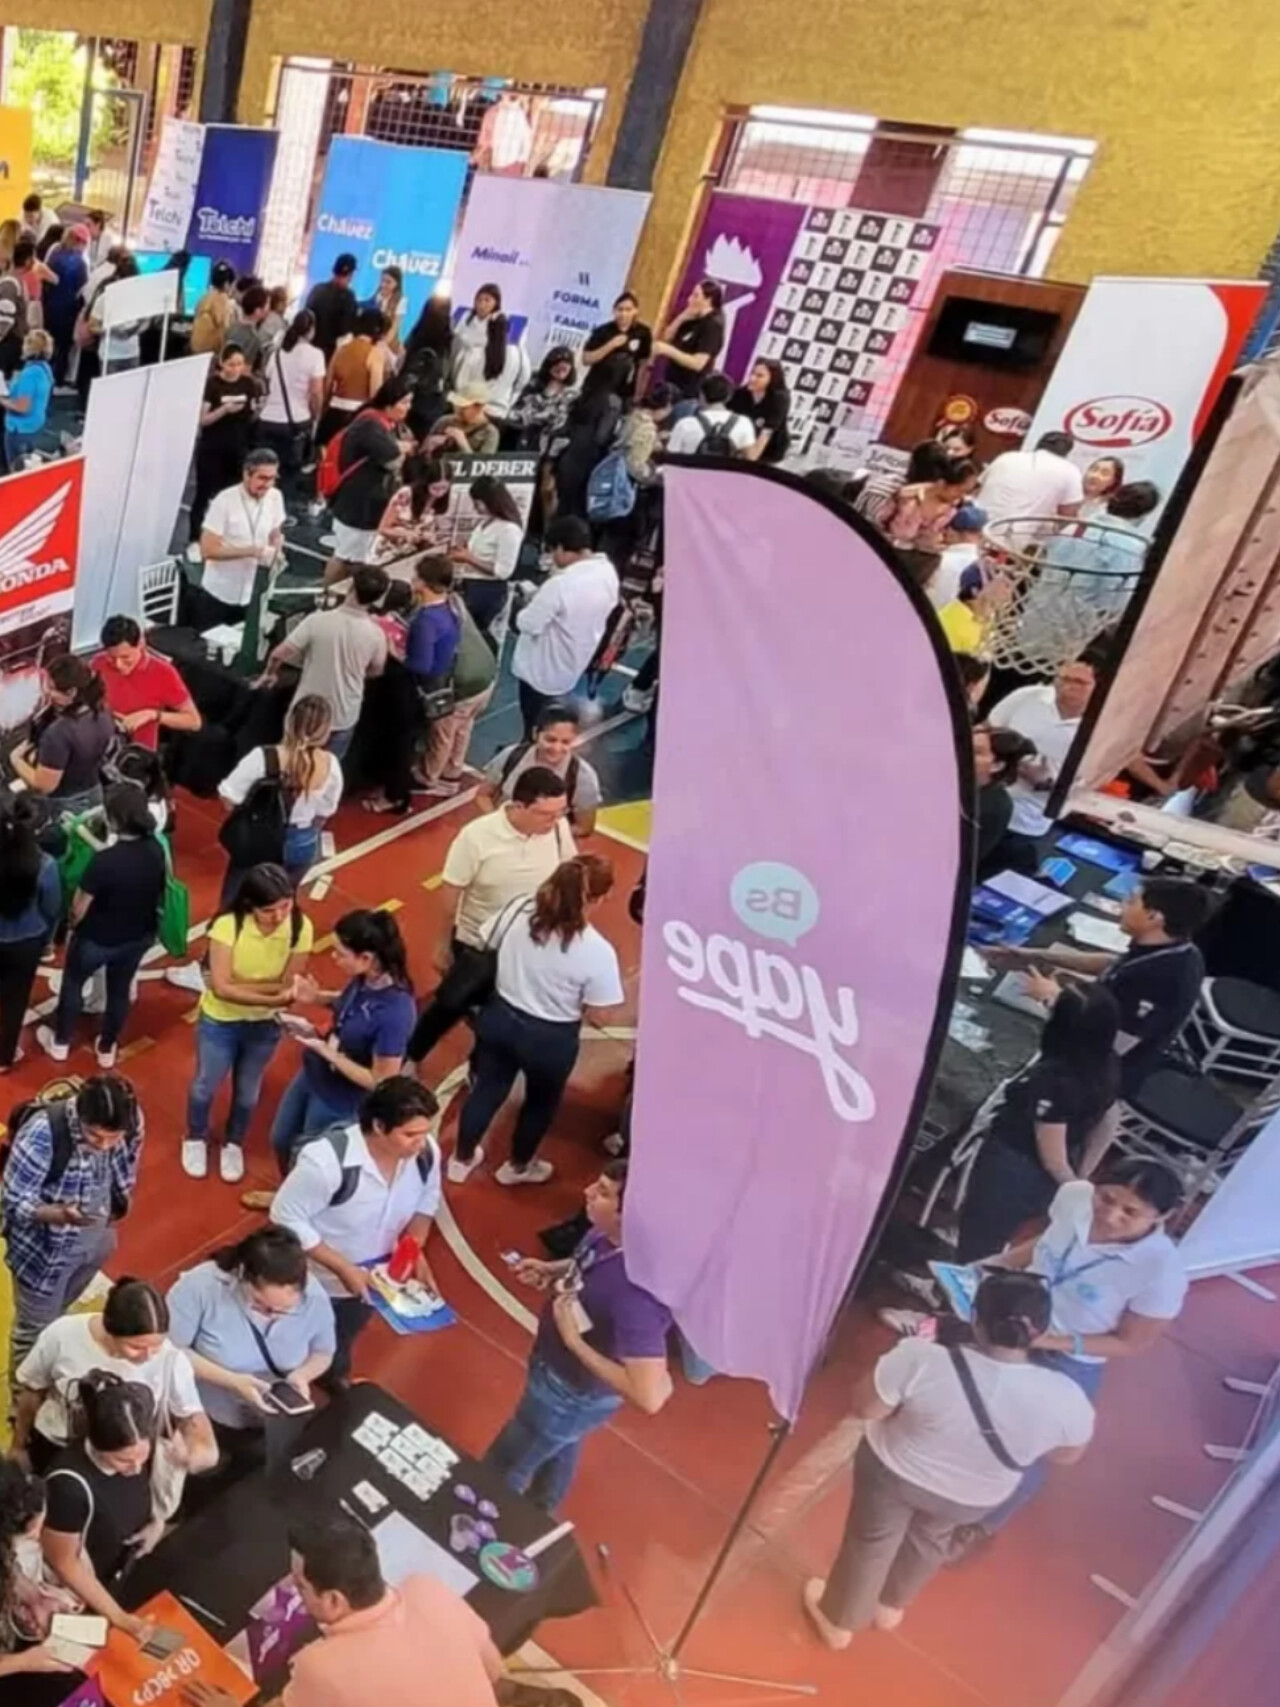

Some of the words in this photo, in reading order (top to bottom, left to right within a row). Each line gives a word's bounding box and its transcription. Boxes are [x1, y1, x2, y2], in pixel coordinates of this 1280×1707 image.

[553, 290, 599, 310] FORMA
[1076, 406, 1160, 436] Sofía
[470, 461, 536, 477] DEBER
